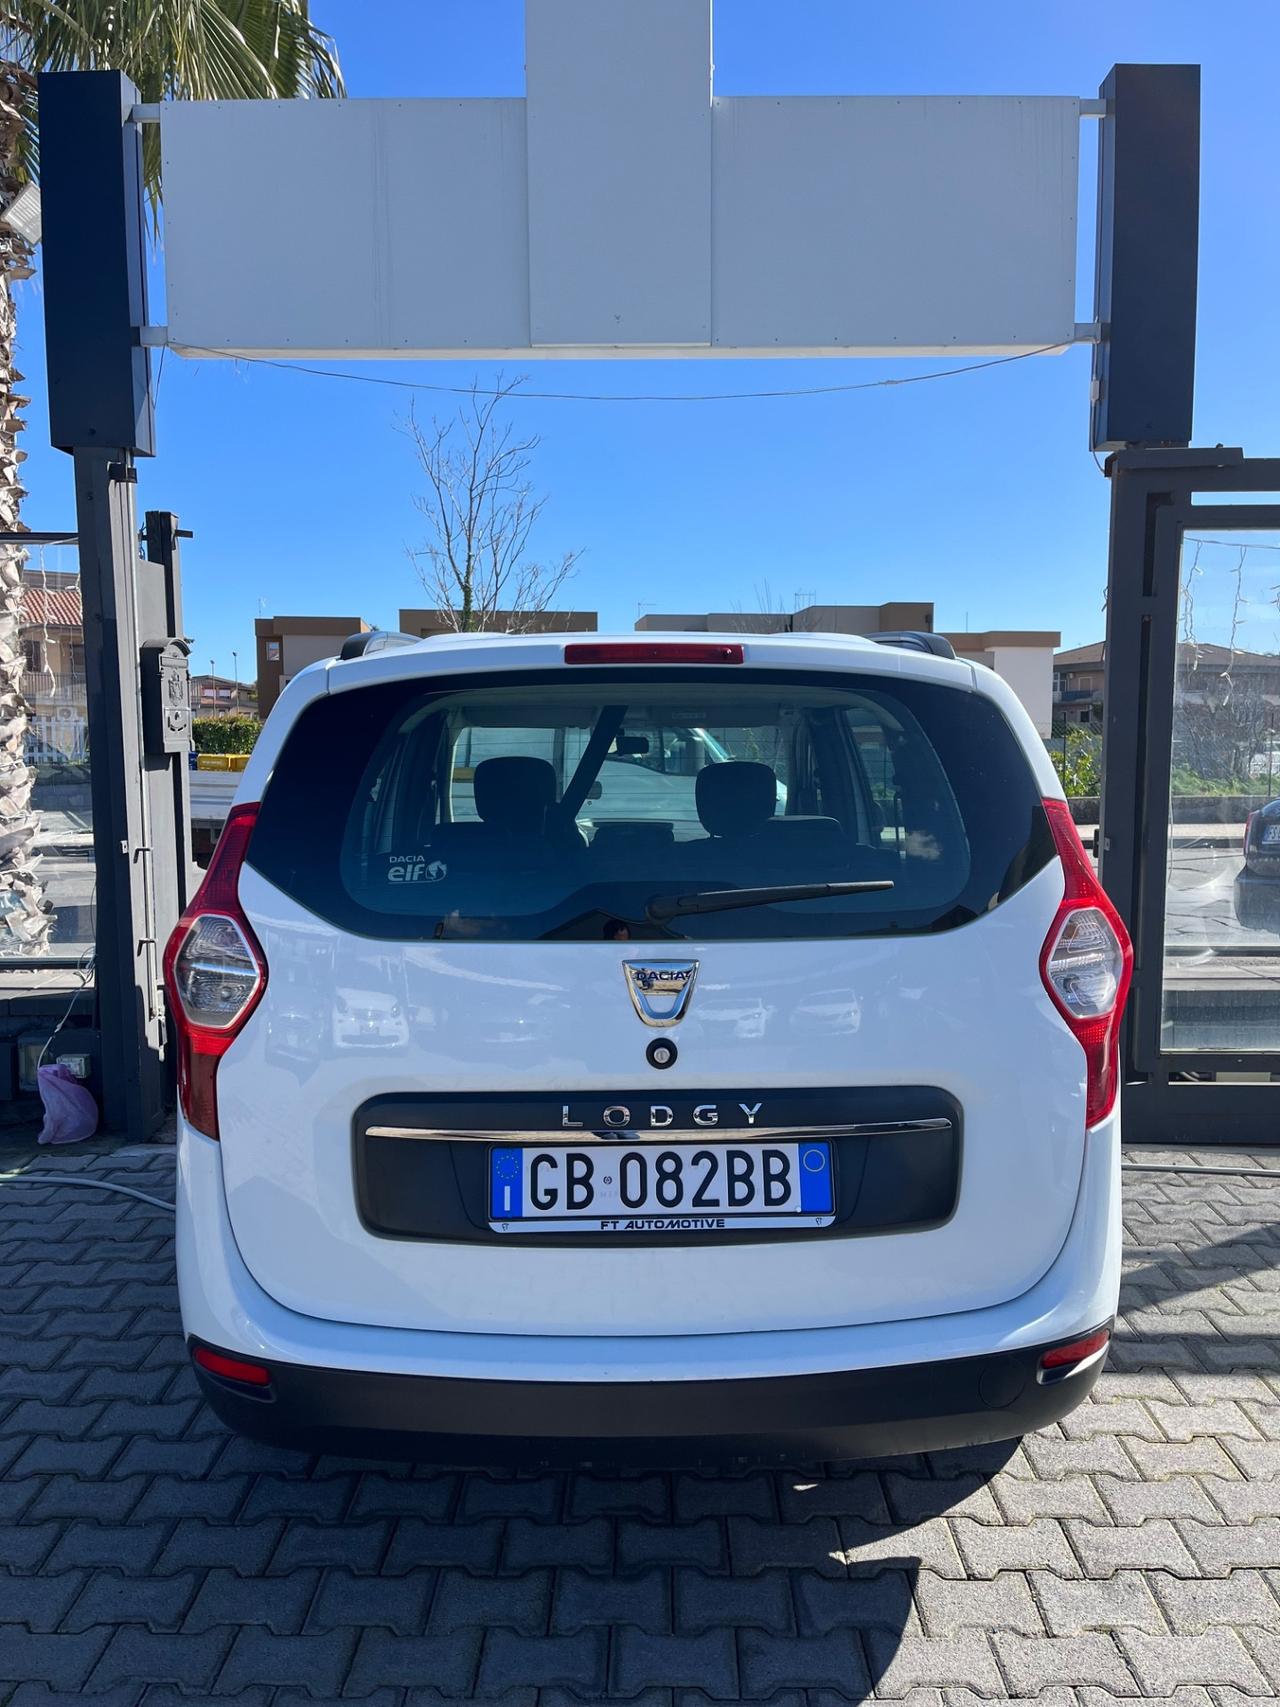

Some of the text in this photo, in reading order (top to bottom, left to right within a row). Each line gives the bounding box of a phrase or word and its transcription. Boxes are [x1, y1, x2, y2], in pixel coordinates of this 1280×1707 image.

[389, 855, 425, 863] DACIA
[388, 863, 425, 881] elf
[637, 971, 686, 981] DACIA
[562, 1102, 763, 1127] LODGY
[530, 1149, 792, 1211] GB 082BB
[601, 1218, 725, 1230] FT AUTOMOTIVE
